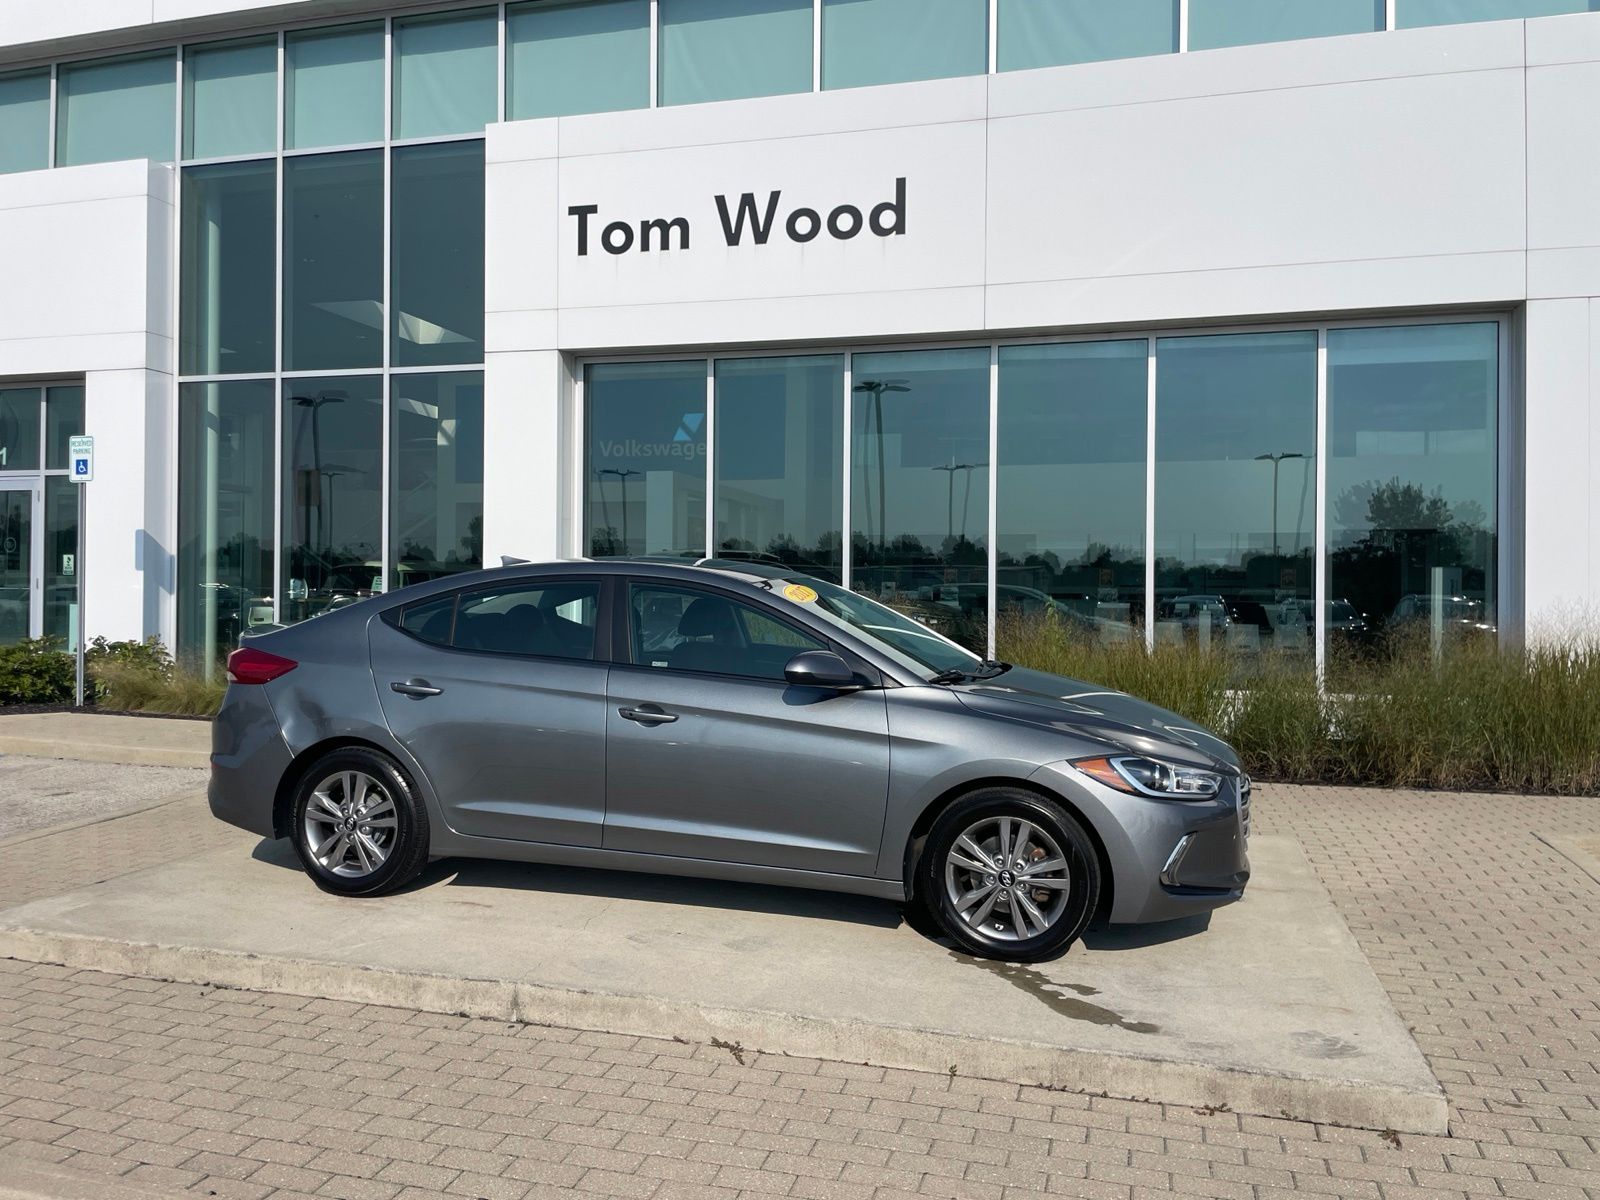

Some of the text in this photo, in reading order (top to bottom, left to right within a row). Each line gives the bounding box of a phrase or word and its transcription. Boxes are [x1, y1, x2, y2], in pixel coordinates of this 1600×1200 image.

[568, 177, 906, 256] Tom Wood
[600, 440, 706, 460] Volkswage
